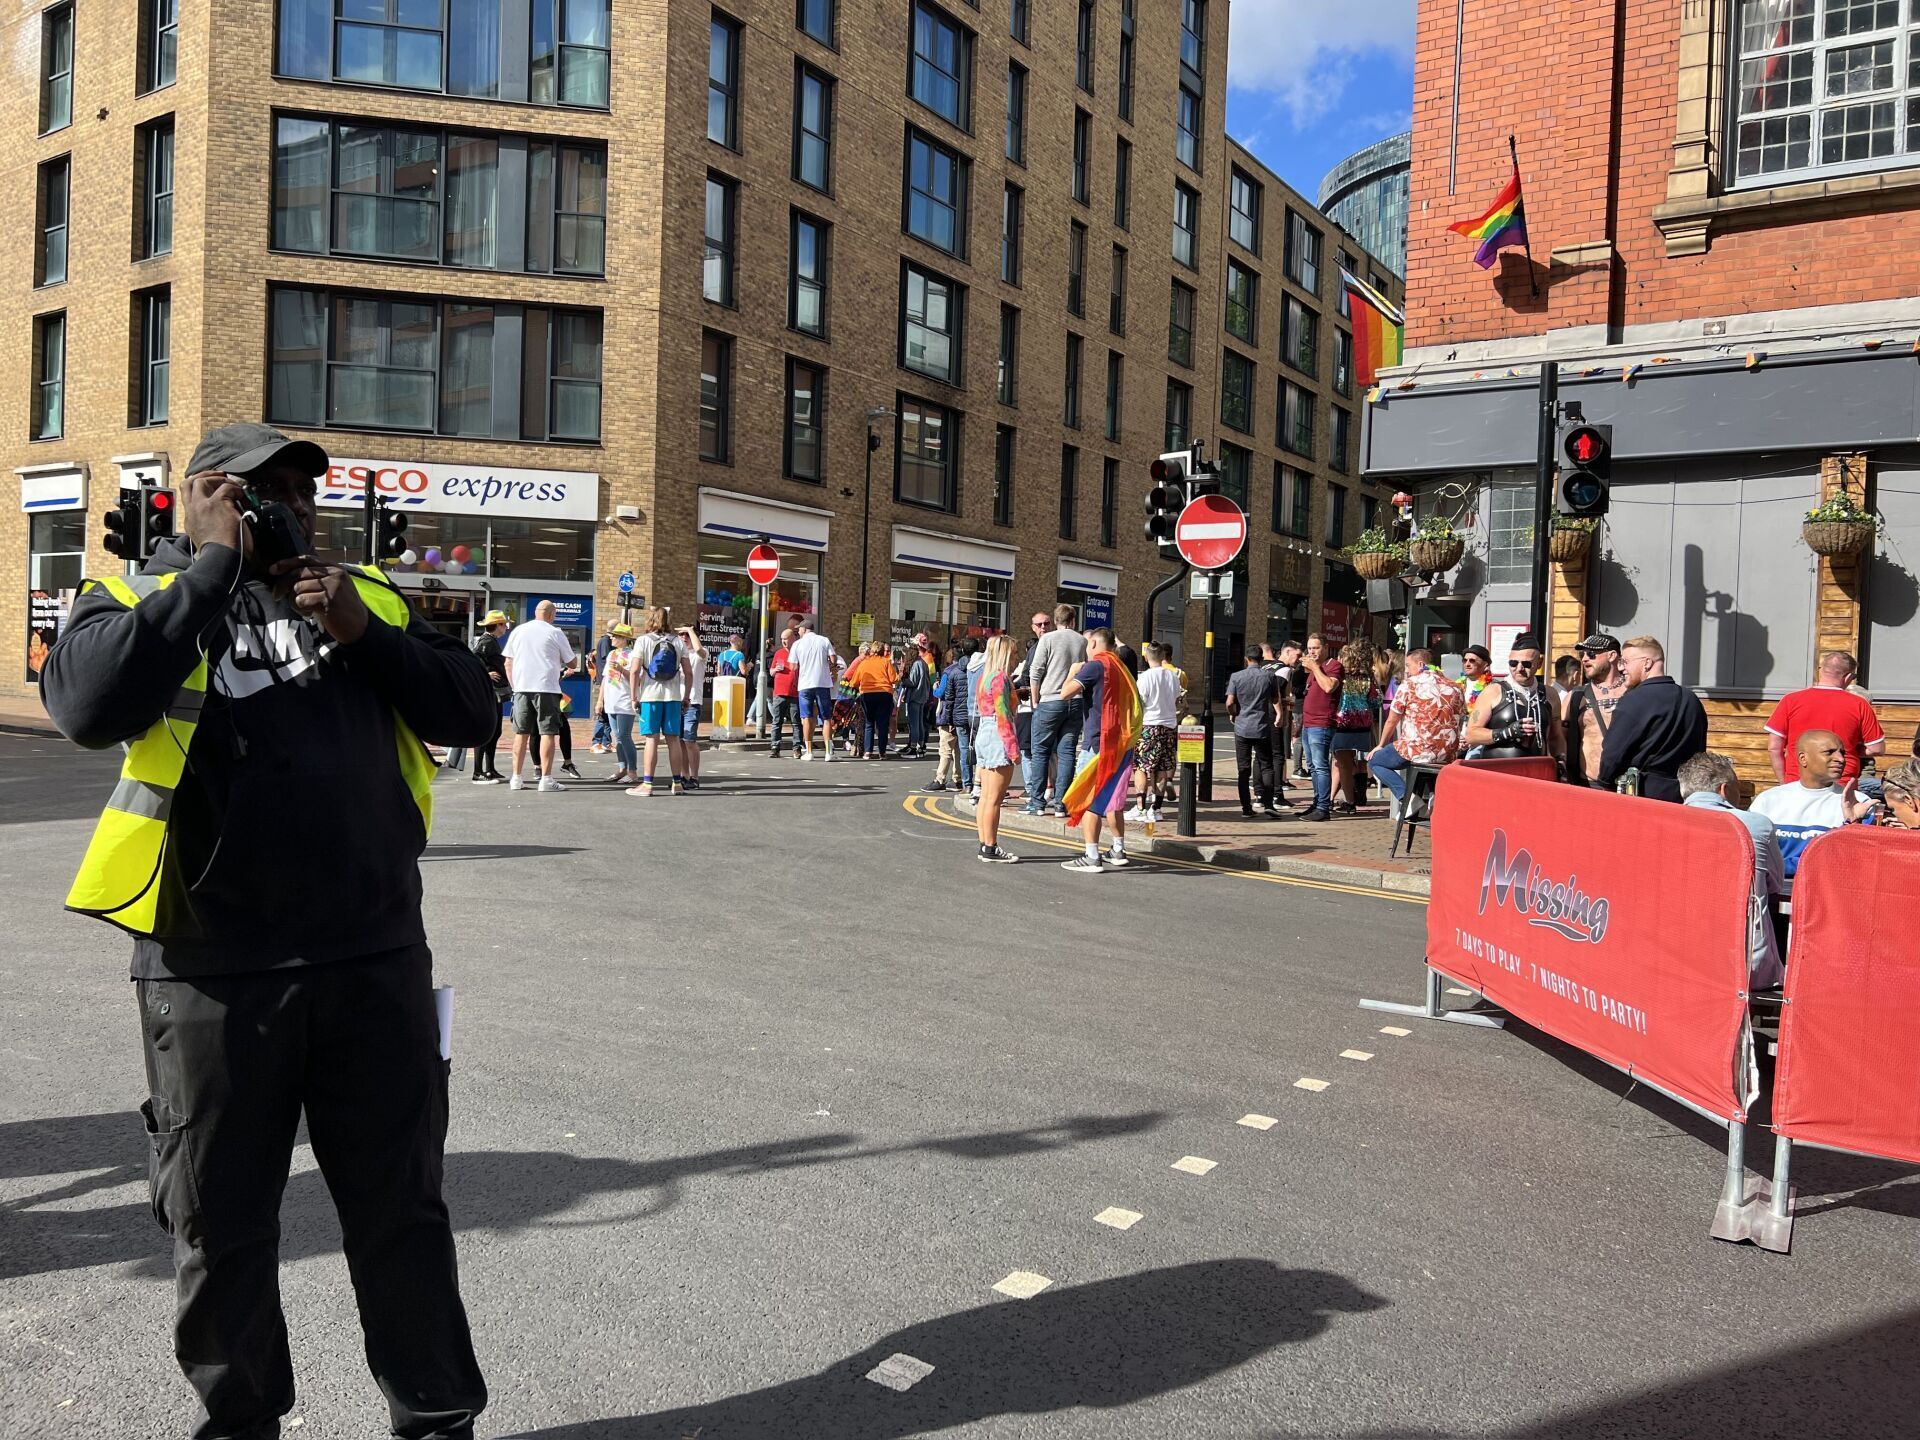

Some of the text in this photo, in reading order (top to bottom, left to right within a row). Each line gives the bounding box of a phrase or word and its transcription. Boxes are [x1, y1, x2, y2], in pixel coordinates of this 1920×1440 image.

[324, 465, 567, 506] ESCO express
[1087, 596, 1109, 607] Entrance
[700, 612, 725, 624] Serving
[1087, 609, 1107, 621] this way
[700, 622, 744, 634] Hurst Street's
[892, 626, 911, 636] Working
[1478, 828, 1609, 944] Missing
[1455, 928, 1460, 945] 7
[1462, 931, 1483, 958] DAYS
[1485, 942, 1496, 963] TO
[1498, 948, 1521, 975] PLAY
[1531, 963, 1536, 983] 7
[1540, 967, 1579, 1004] NIGHTS
[1582, 986, 1597, 1012] TO
[1601, 994, 1647, 1036] PARTY!
